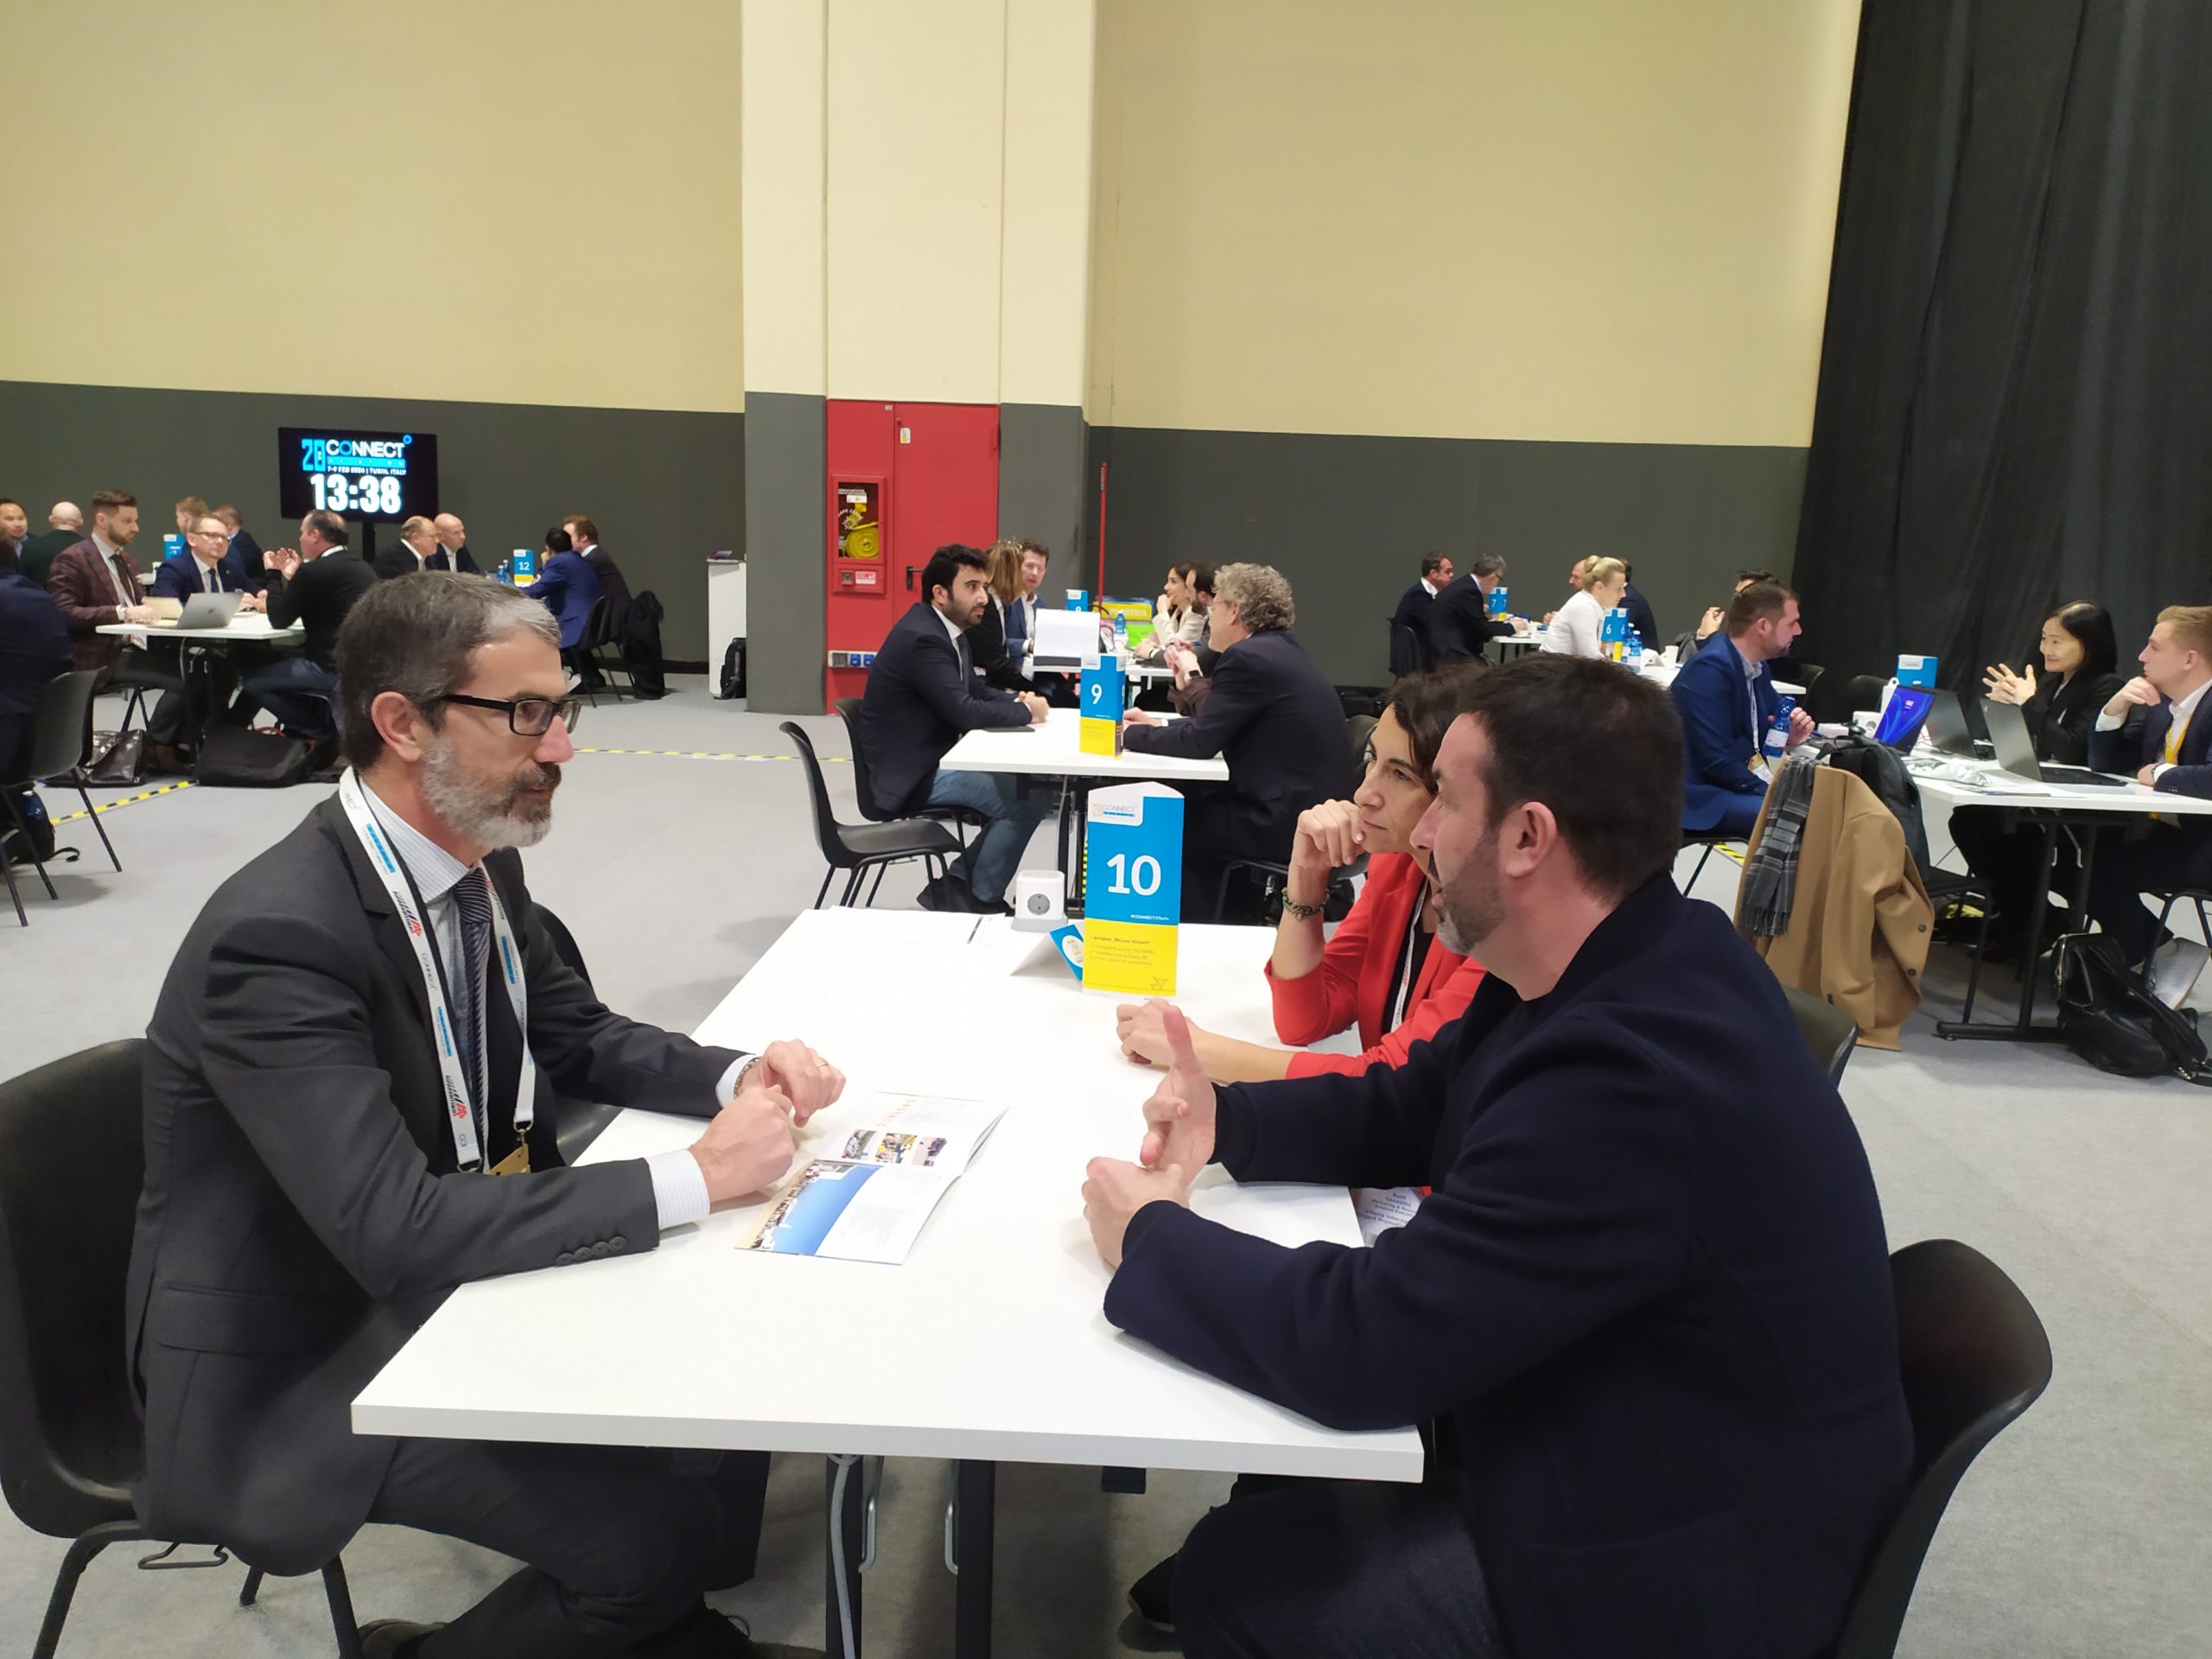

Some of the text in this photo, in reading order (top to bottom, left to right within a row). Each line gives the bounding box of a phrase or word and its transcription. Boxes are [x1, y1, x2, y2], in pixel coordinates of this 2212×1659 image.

[326, 439, 405, 458] CONNECT
[310, 474, 402, 514] 13:38
[518, 562, 530, 571] 12
[1491, 599, 1497, 607] 7
[1605, 624, 1611, 635] 6
[1620, 624, 1625, 635] 6
[1091, 683, 1103, 705] 9
[1106, 853, 1161, 896] 10
